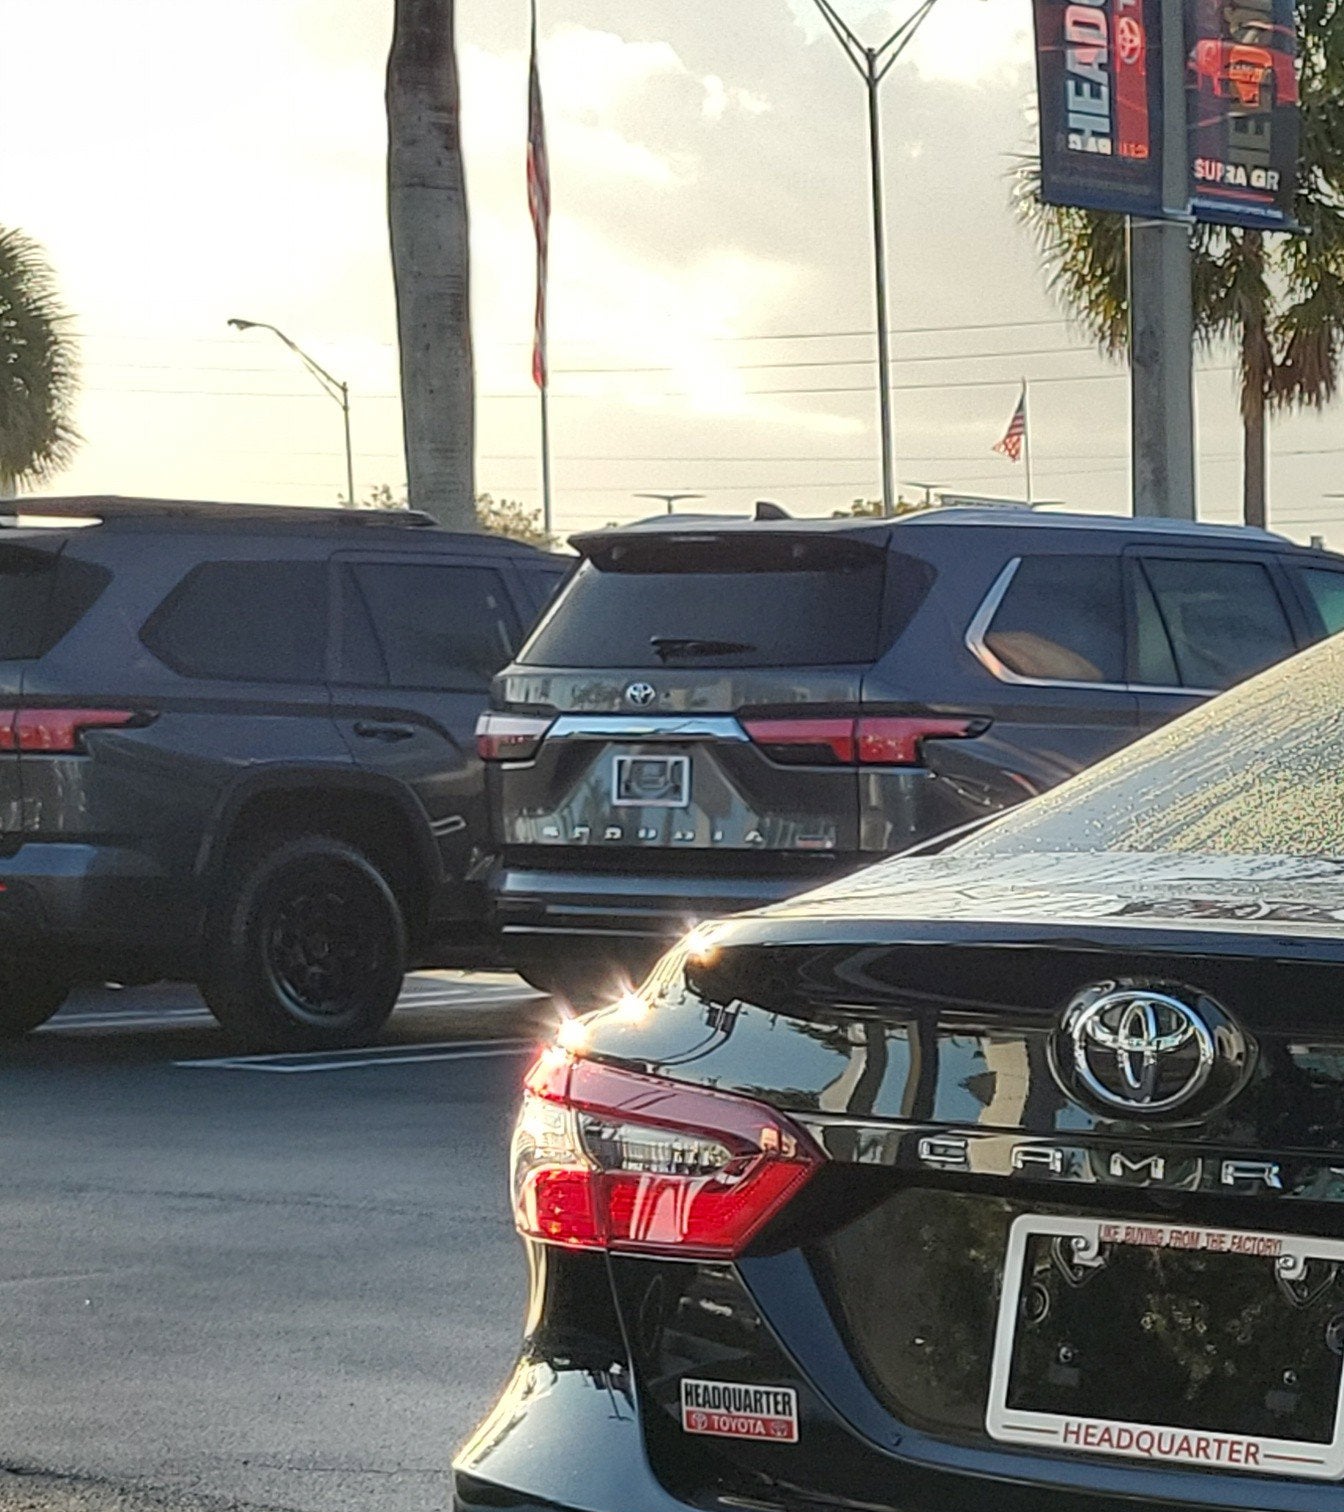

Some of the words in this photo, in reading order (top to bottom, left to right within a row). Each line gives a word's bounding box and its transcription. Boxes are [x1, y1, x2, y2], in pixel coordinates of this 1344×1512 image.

[1064, 0, 1112, 154] HEAD
[1194, 158, 1247, 188] SUPRA
[1250, 167, 1280, 191] GR
[1125, 1226, 1164, 1247] BUYING
[1169, 1229, 1201, 1249] FROM
[1205, 1232, 1227, 1251] THE
[684, 1381, 793, 1416] HEADQUARTER
[711, 1414, 766, 1435] TOYOTA
[1062, 1421, 1261, 1465] HEADQUARTER
